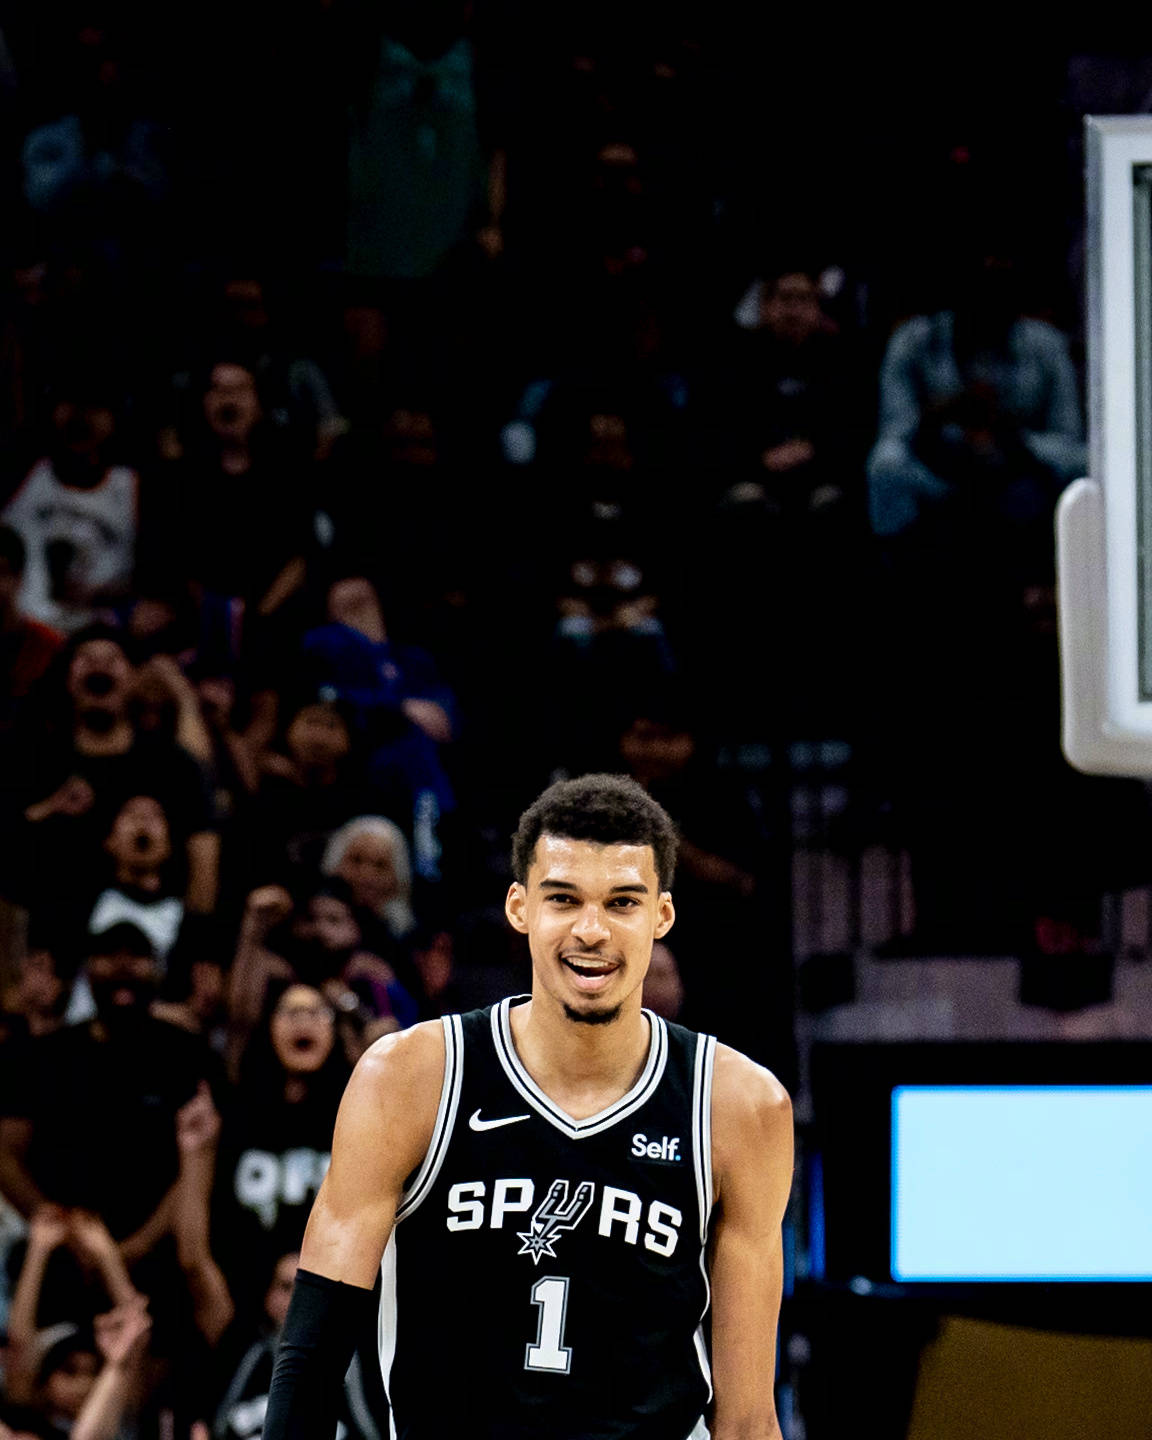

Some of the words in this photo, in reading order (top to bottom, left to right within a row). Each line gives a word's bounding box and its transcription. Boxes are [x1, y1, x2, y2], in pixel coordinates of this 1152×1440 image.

[631, 1133, 682, 1161] Self.
[446, 1178, 683, 1266] SPURS
[524, 1275, 573, 1375] 1
